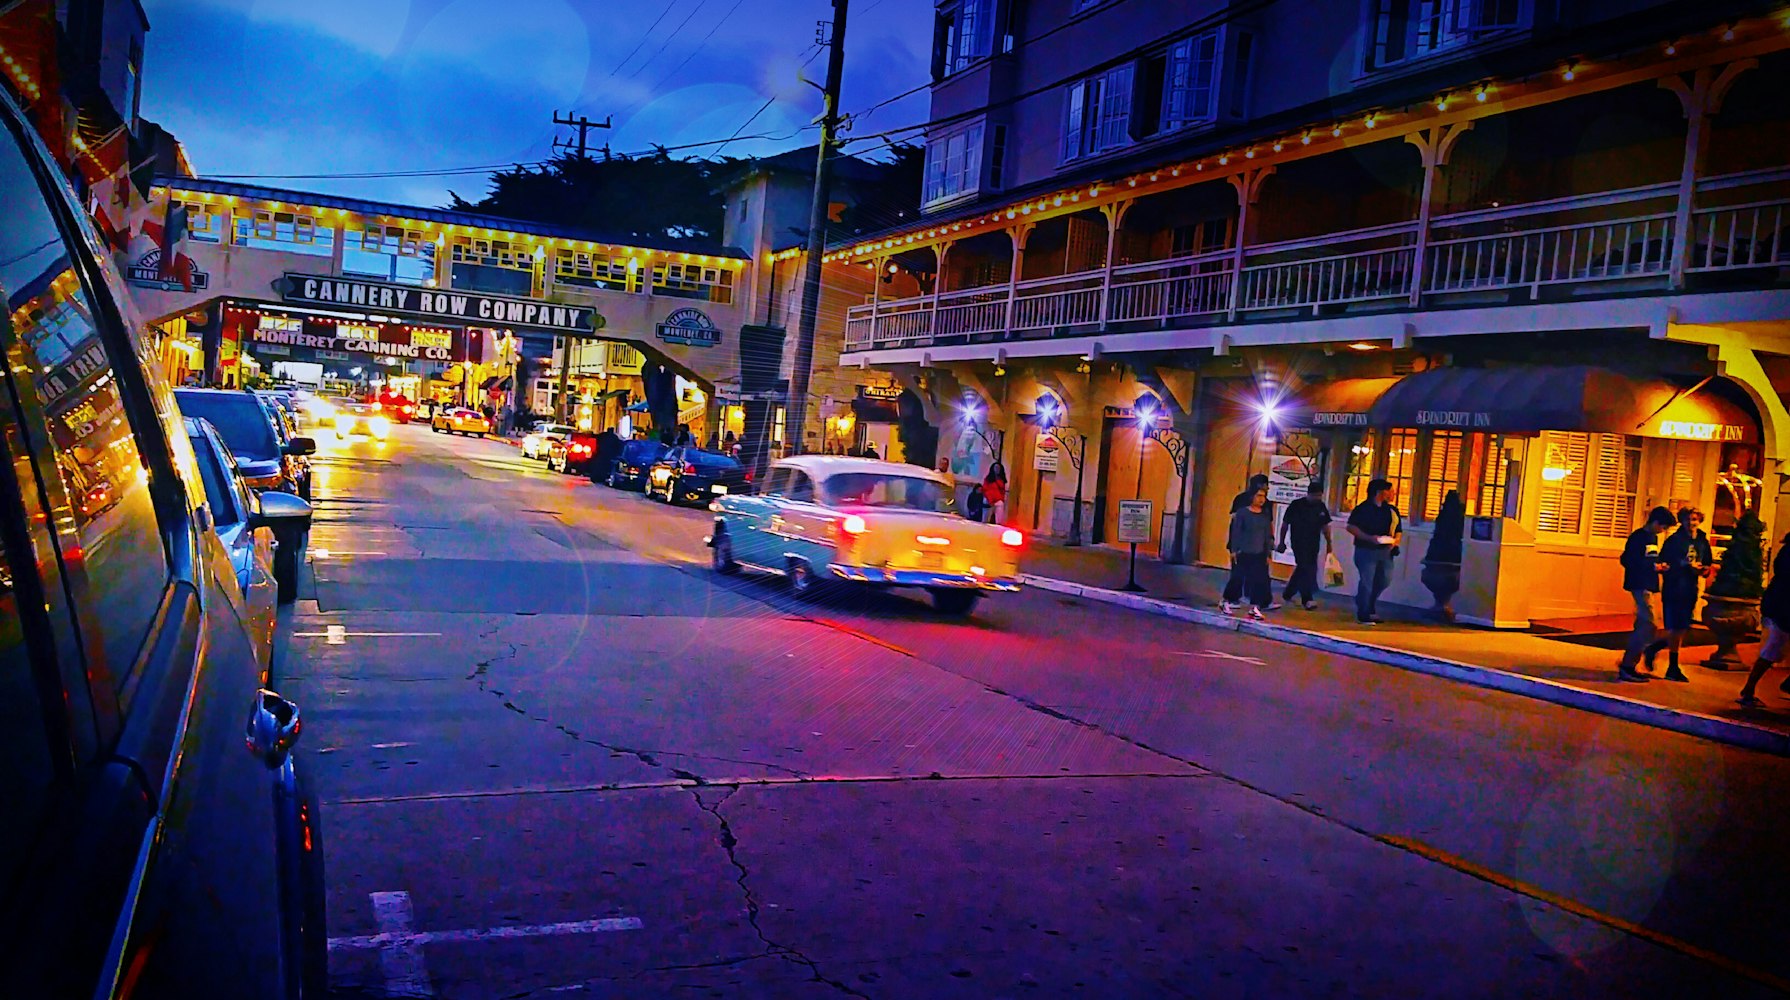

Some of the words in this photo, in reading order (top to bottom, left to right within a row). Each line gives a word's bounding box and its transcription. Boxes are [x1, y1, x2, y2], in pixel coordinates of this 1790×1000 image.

[304, 279, 408, 309] CANNERY
[420, 292, 468, 315] ROW
[479, 299, 580, 328] COMPANY
[253, 329, 337, 349] MONTEREY
[344, 339, 419, 357] CANNING
[425, 346, 452, 360] CO.
[1312, 412, 1353, 425] SPINDRIFT
[1355, 413, 1368, 425] INN
[1416, 410, 1470, 425] SPINDRIFT
[1474, 411, 1491, 426] INN
[1660, 420, 1723, 440] SPINDRIFT
[1725, 425, 1744, 440] INN
